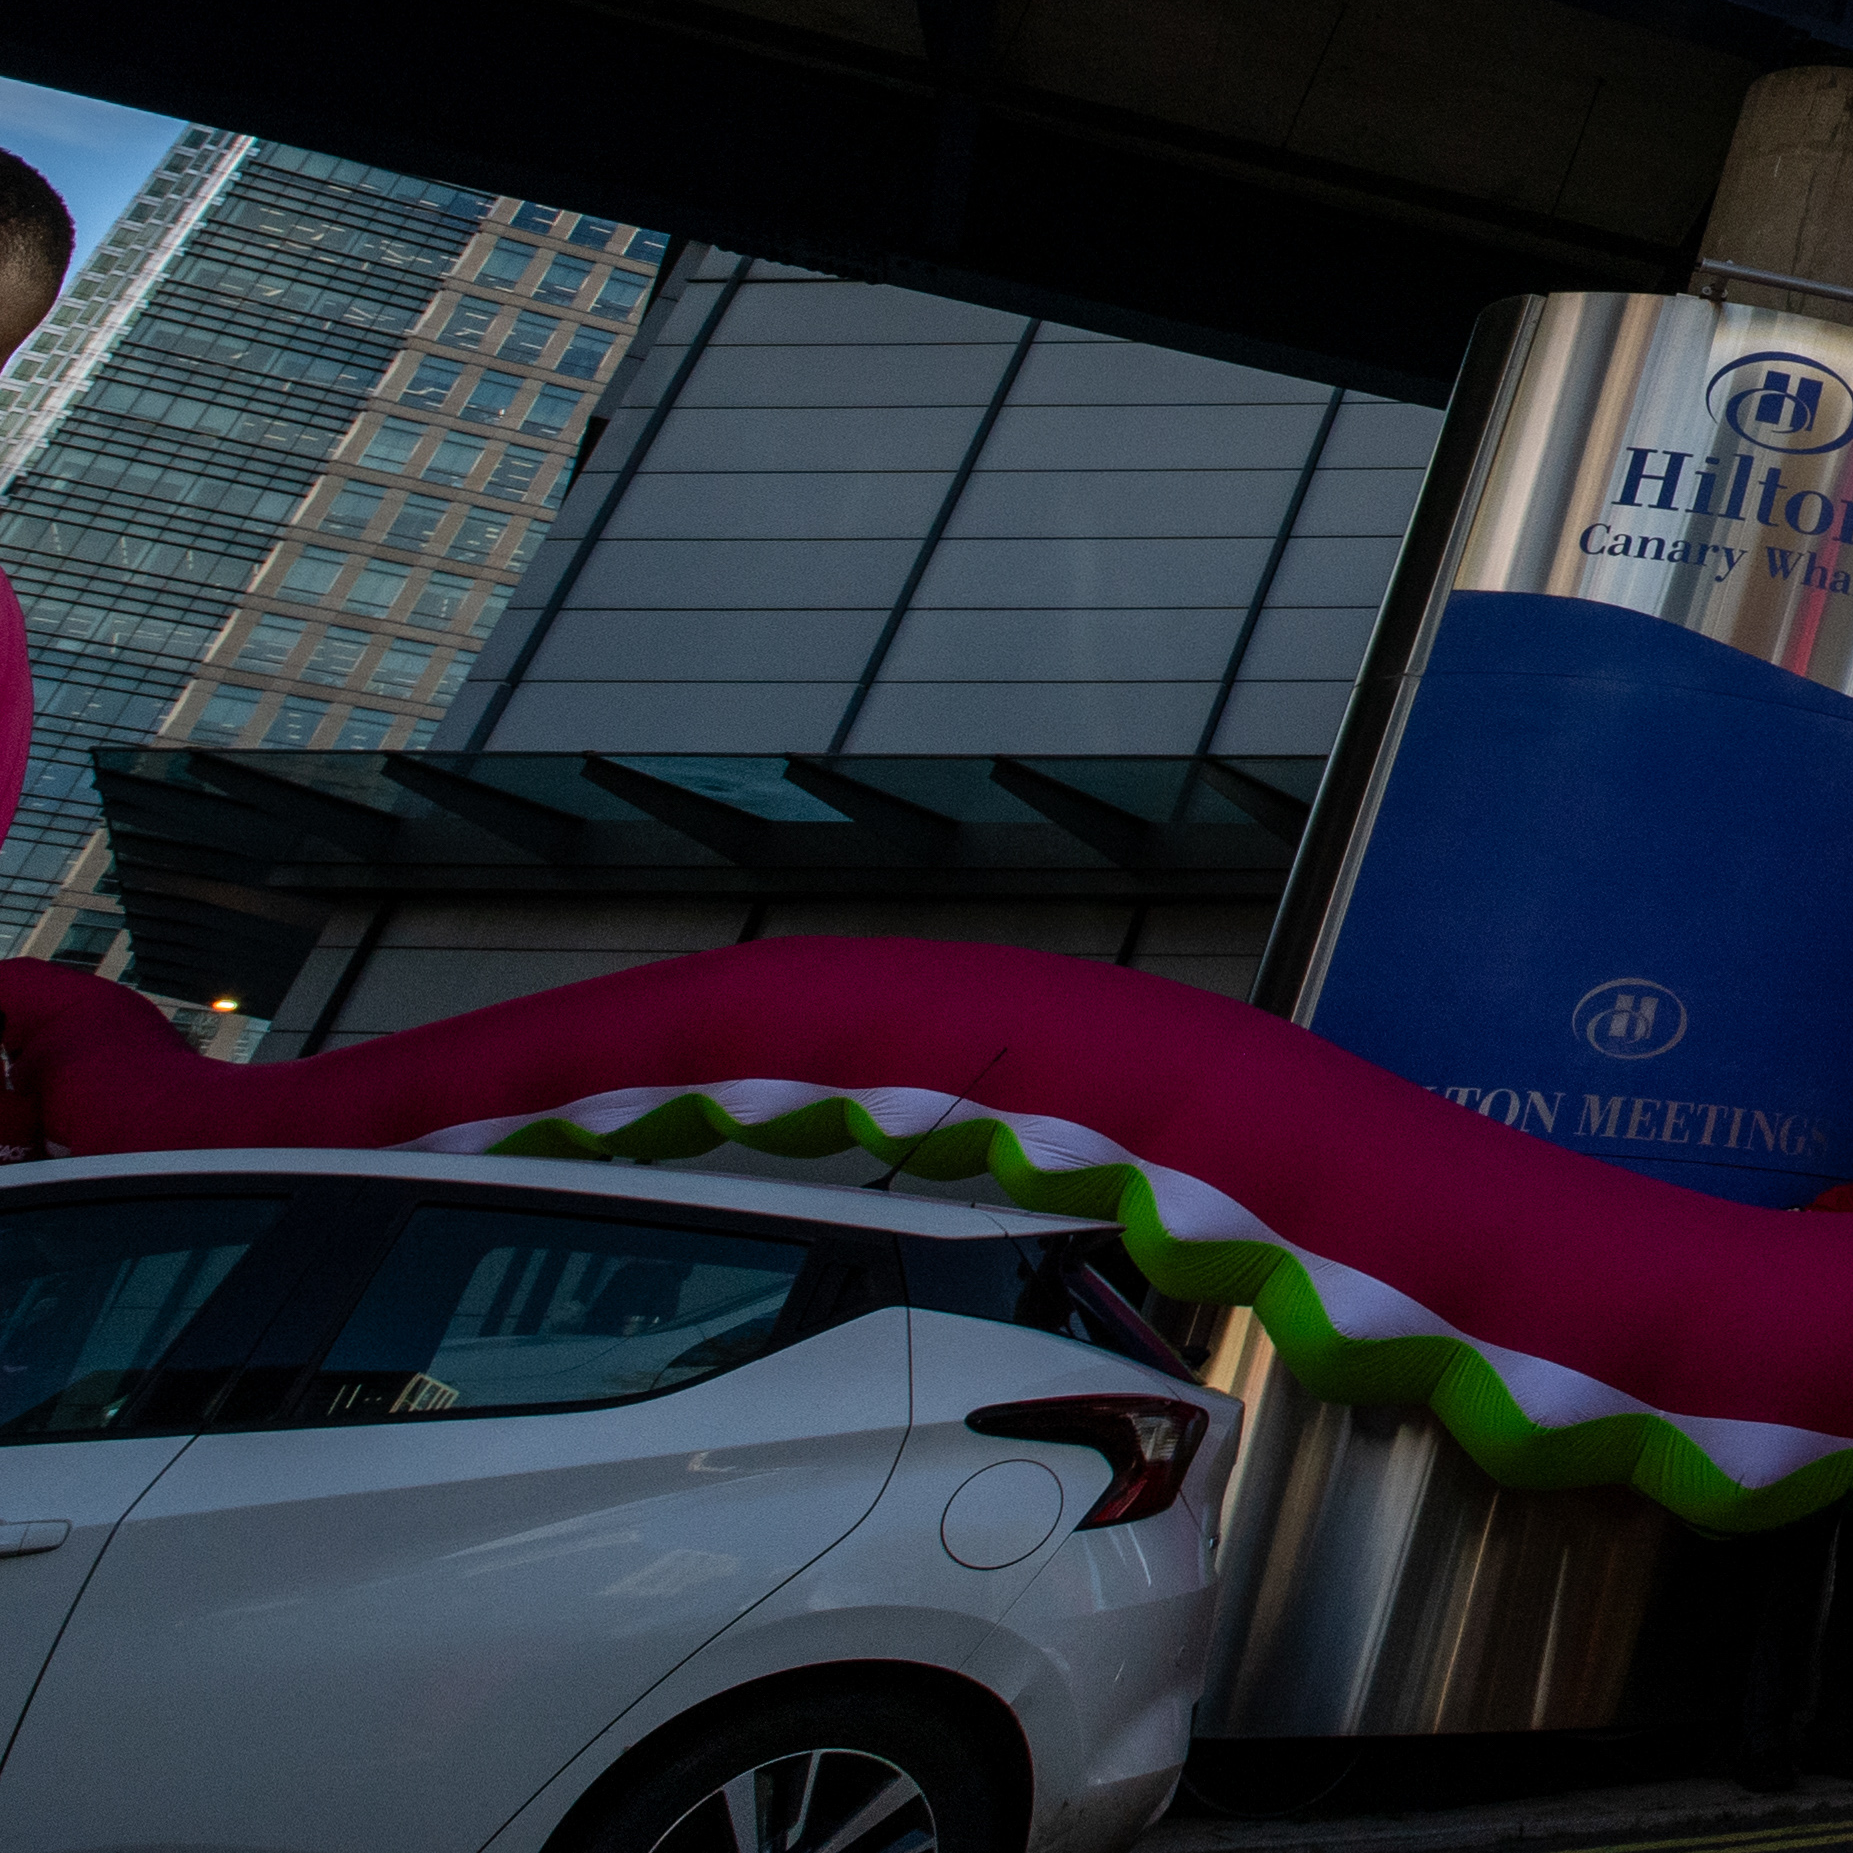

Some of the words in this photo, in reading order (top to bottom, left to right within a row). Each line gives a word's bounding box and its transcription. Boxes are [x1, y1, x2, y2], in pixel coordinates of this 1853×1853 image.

[1578, 522, 1748, 583] Canary
[1423, 1085, 1567, 1134] TON
[1573, 1092, 1834, 1158] MEETINGS
